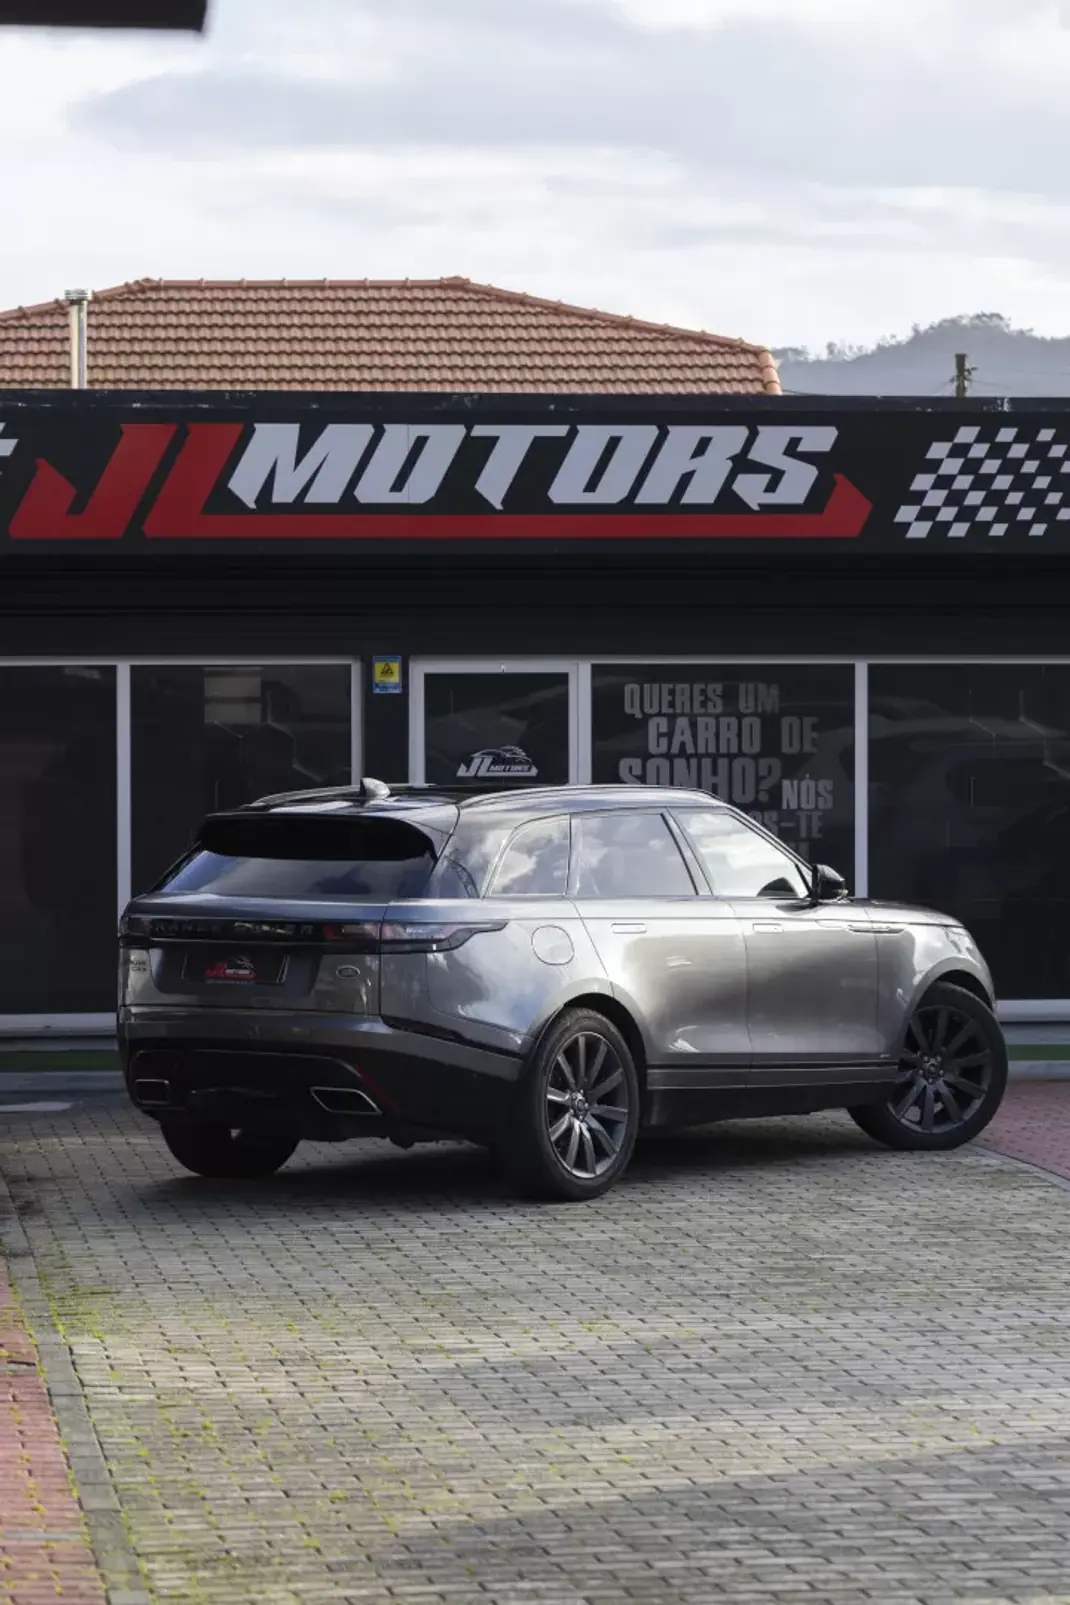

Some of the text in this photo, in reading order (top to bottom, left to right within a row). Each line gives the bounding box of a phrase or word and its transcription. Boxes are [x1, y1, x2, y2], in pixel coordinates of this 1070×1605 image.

[8, 423, 839, 539] JL MOTORS
[624, 683, 779, 718] QUERES UM
[648, 716, 819, 754] CARRO DE
[781, 773, 834, 810] NÓS
